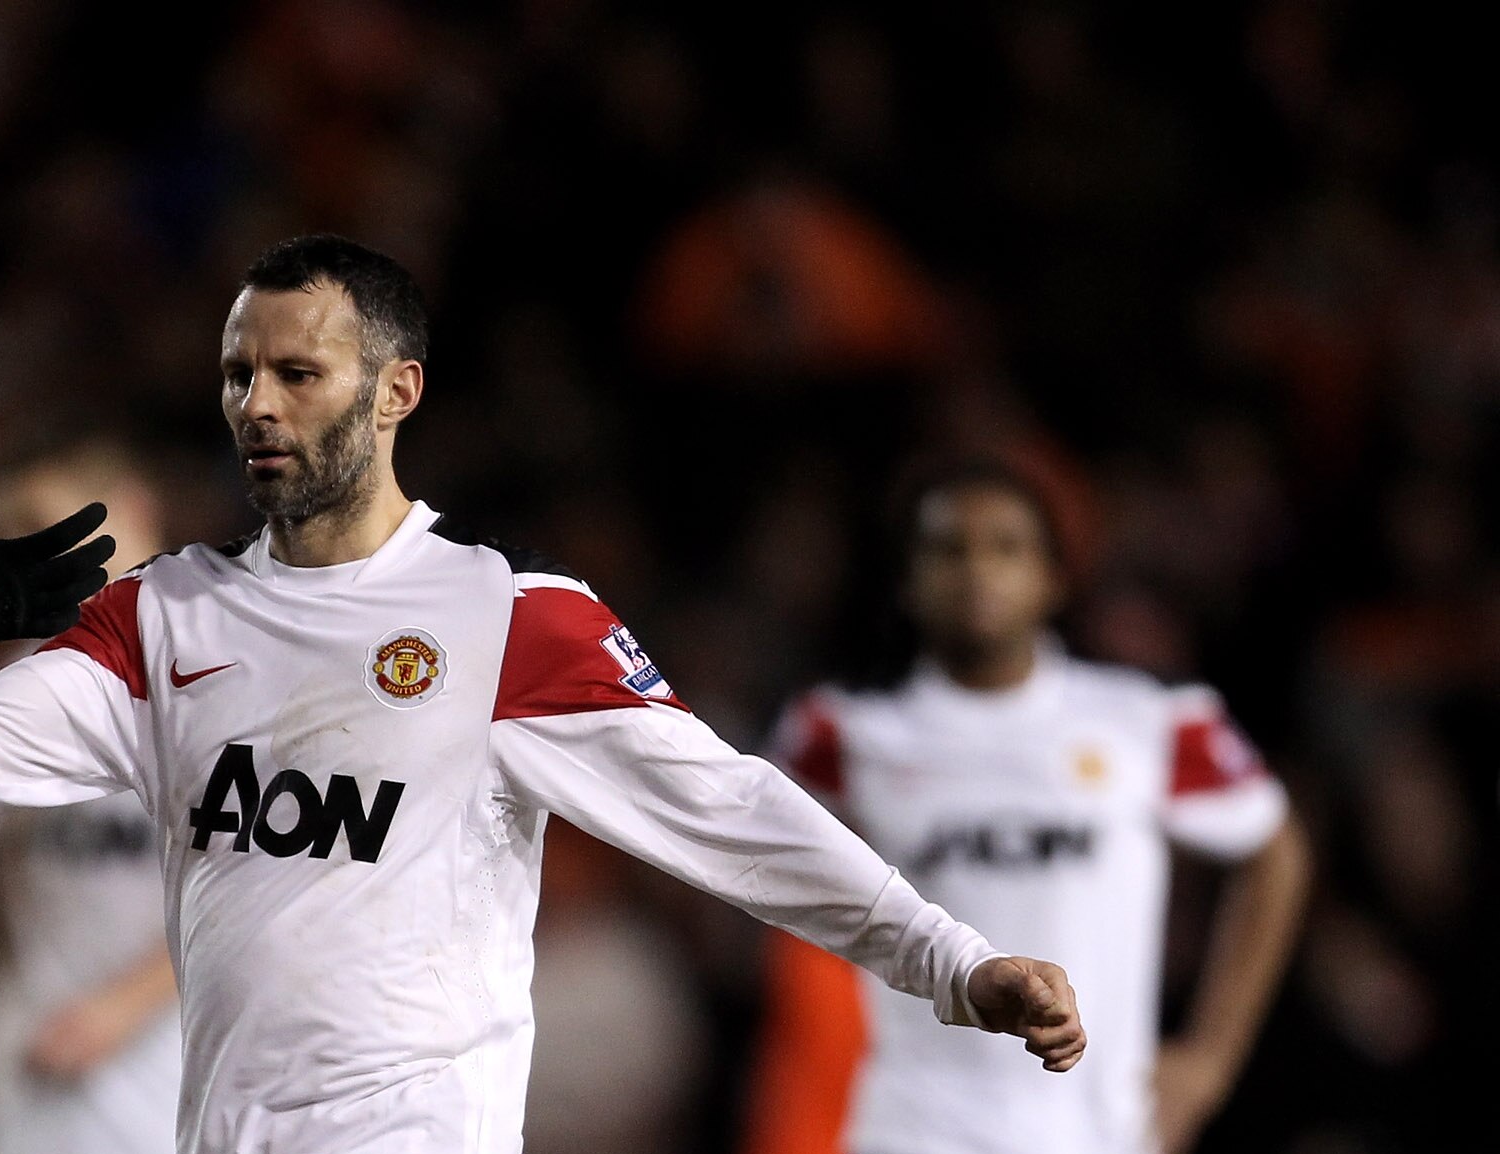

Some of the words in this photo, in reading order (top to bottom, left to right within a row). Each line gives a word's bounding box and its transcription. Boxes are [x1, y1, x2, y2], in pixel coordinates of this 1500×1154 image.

[381, 640, 434, 662] MANCHESTER
[385, 682, 422, 694] UNITED
[189, 742, 407, 864] AON
